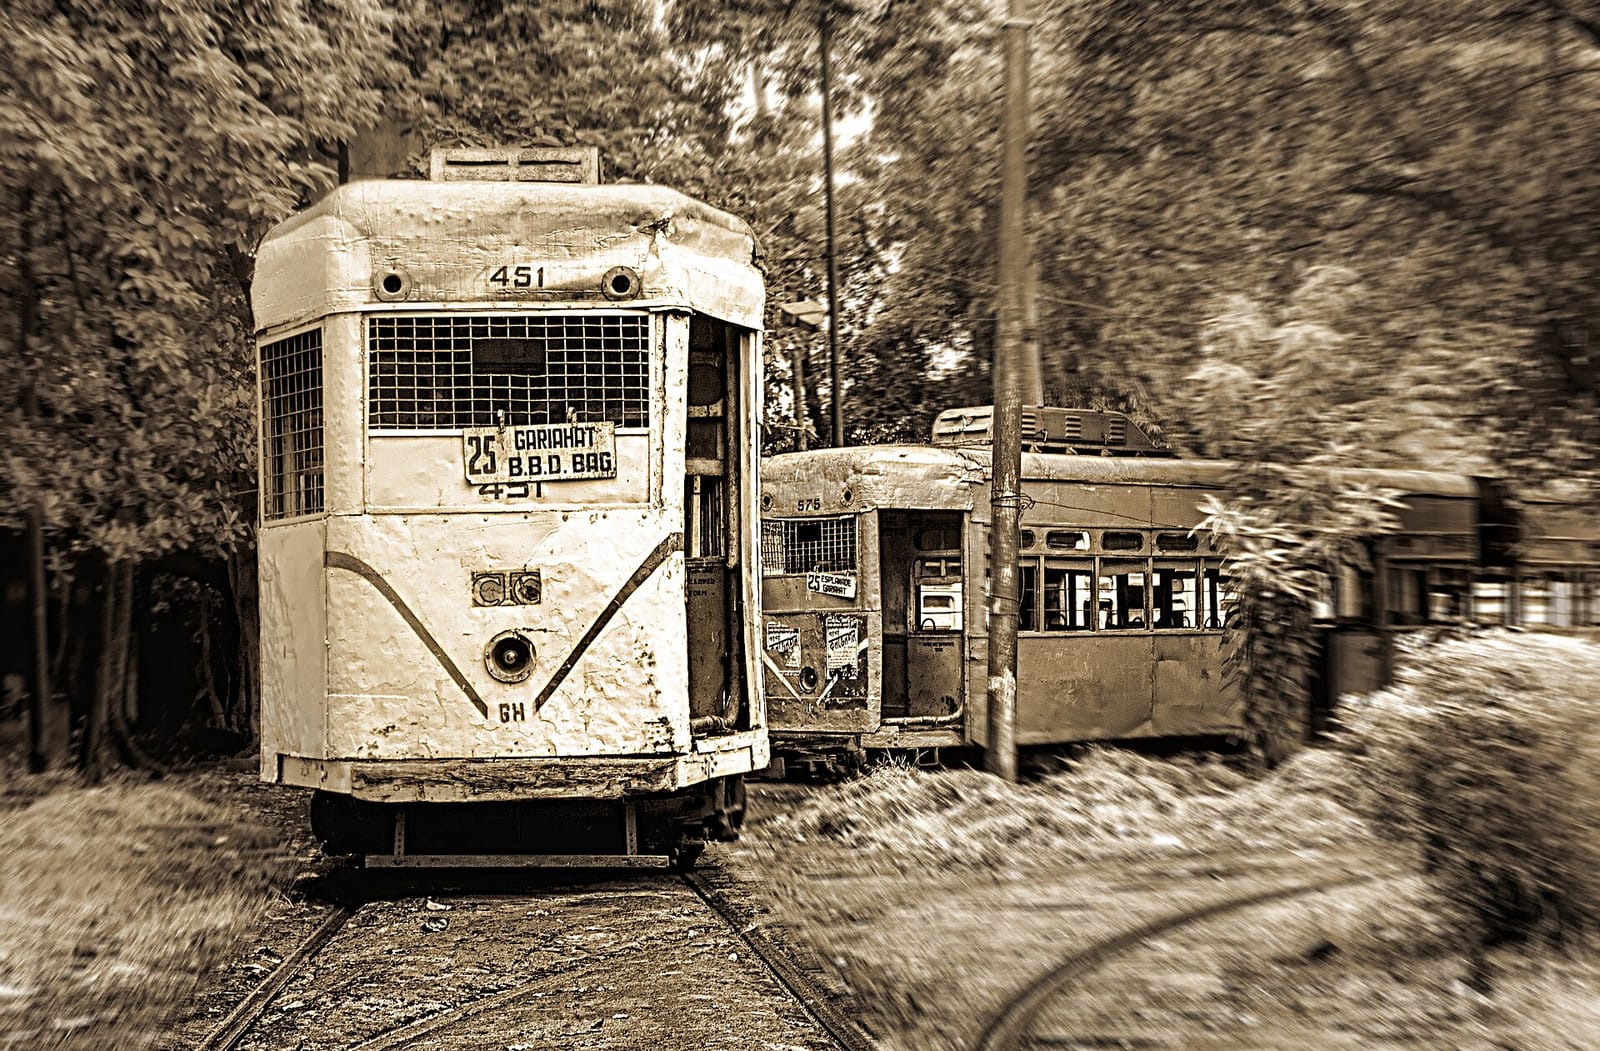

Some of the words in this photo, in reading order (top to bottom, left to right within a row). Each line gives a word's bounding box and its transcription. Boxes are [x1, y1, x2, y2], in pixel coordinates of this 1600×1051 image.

[490, 266, 543, 288] 451
[514, 427, 596, 451] GARIAHAT
[467, 436, 497, 475] 25
[508, 454, 567, 477] B.B.D.
[808, 574, 820, 591] 25
[500, 702, 525, 723] GH
